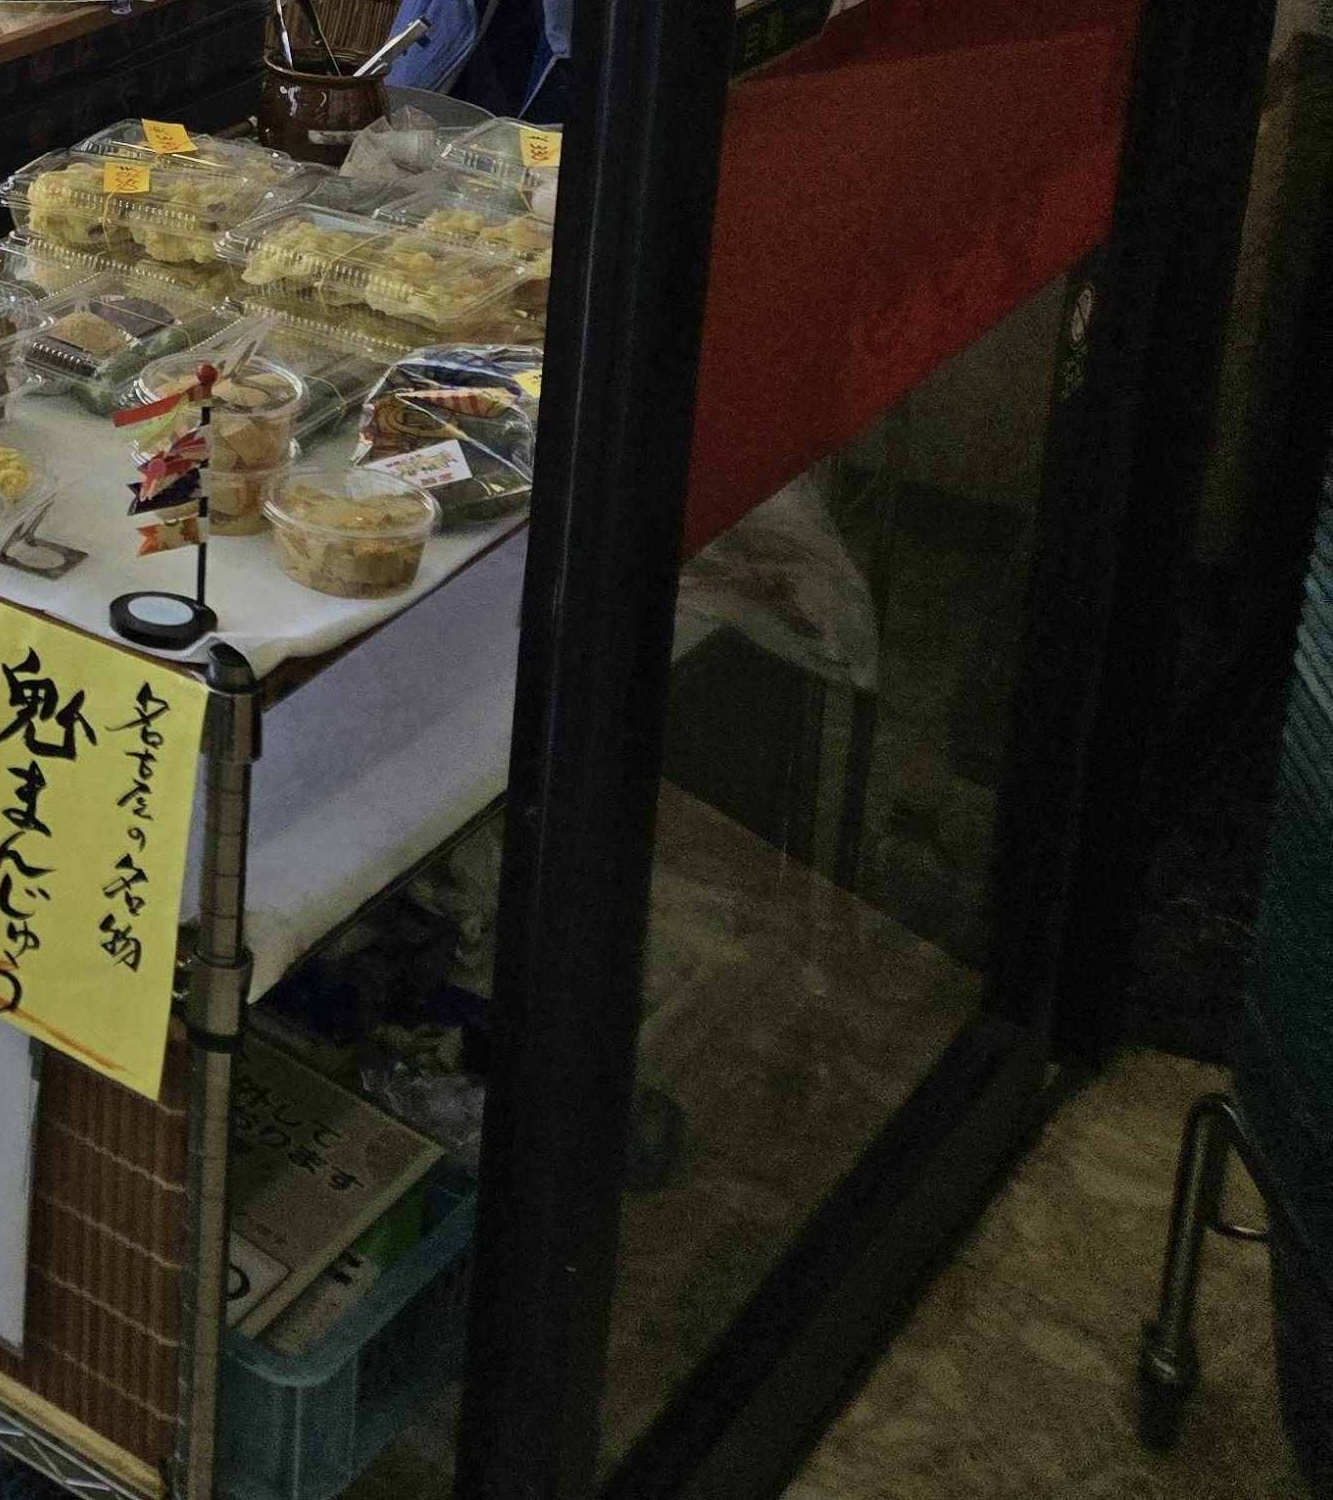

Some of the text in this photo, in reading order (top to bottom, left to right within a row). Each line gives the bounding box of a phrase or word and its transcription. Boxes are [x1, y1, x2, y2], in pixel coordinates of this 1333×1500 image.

[99, 679, 172, 975] 名古屋の名物
